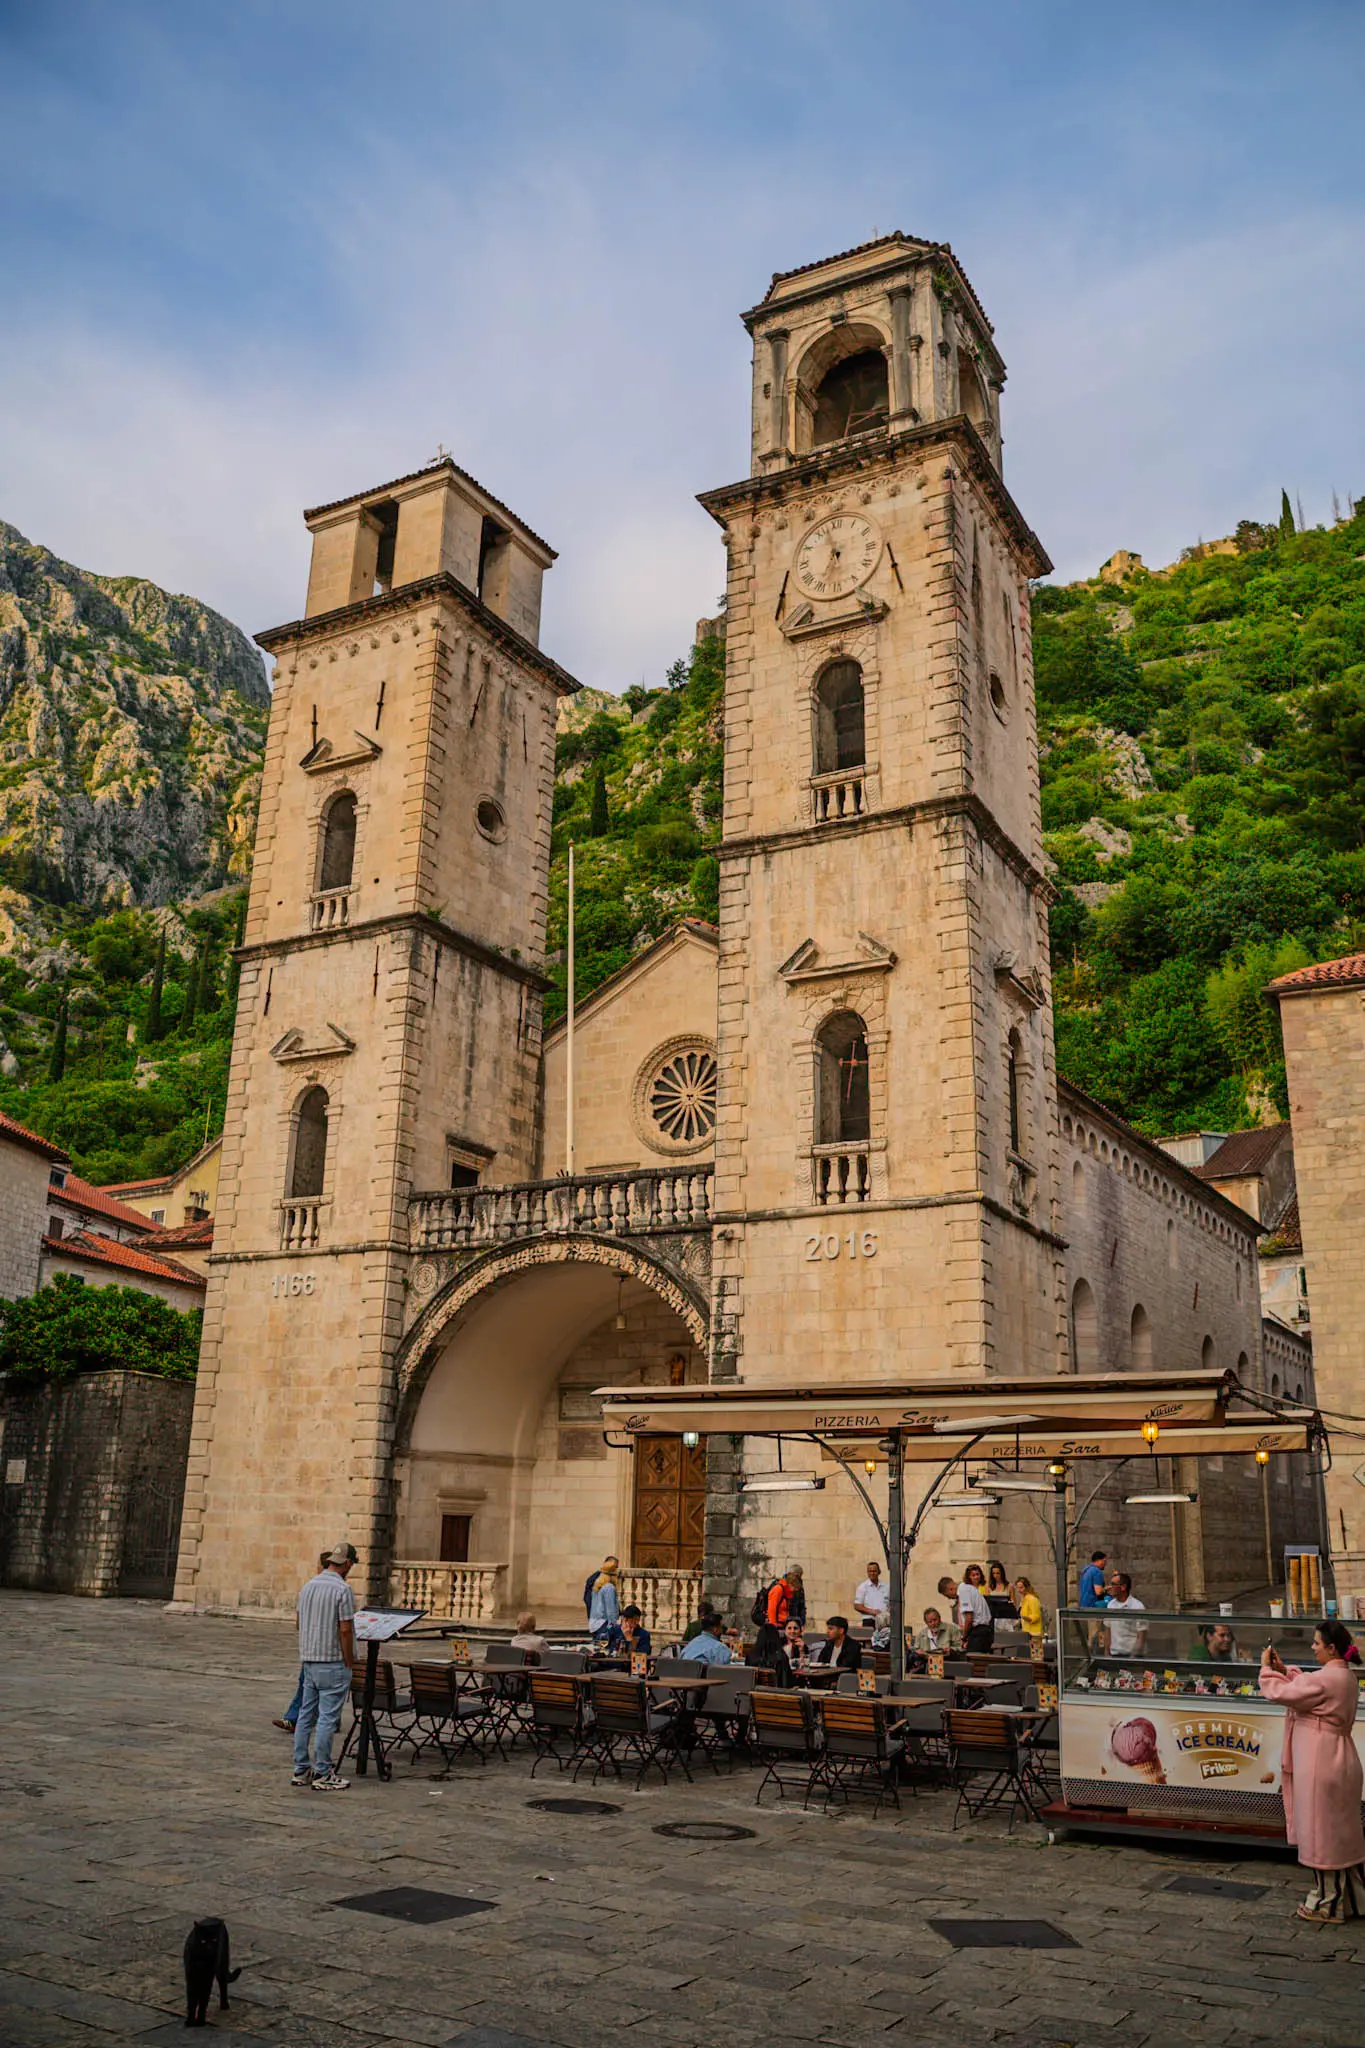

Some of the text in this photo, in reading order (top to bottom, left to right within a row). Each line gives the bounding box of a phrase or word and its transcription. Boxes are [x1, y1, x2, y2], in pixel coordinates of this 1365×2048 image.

[804, 1230, 878, 1261] 2016
[271, 1273, 316, 1297] 1166
[815, 1411, 950, 1427] PIZZERIA Sara
[992, 1441, 1101, 1456] PIZZERIA Sara
[1172, 1723, 1264, 1743] PREMIUM
[1176, 1734, 1261, 1756] ICE CREAM
